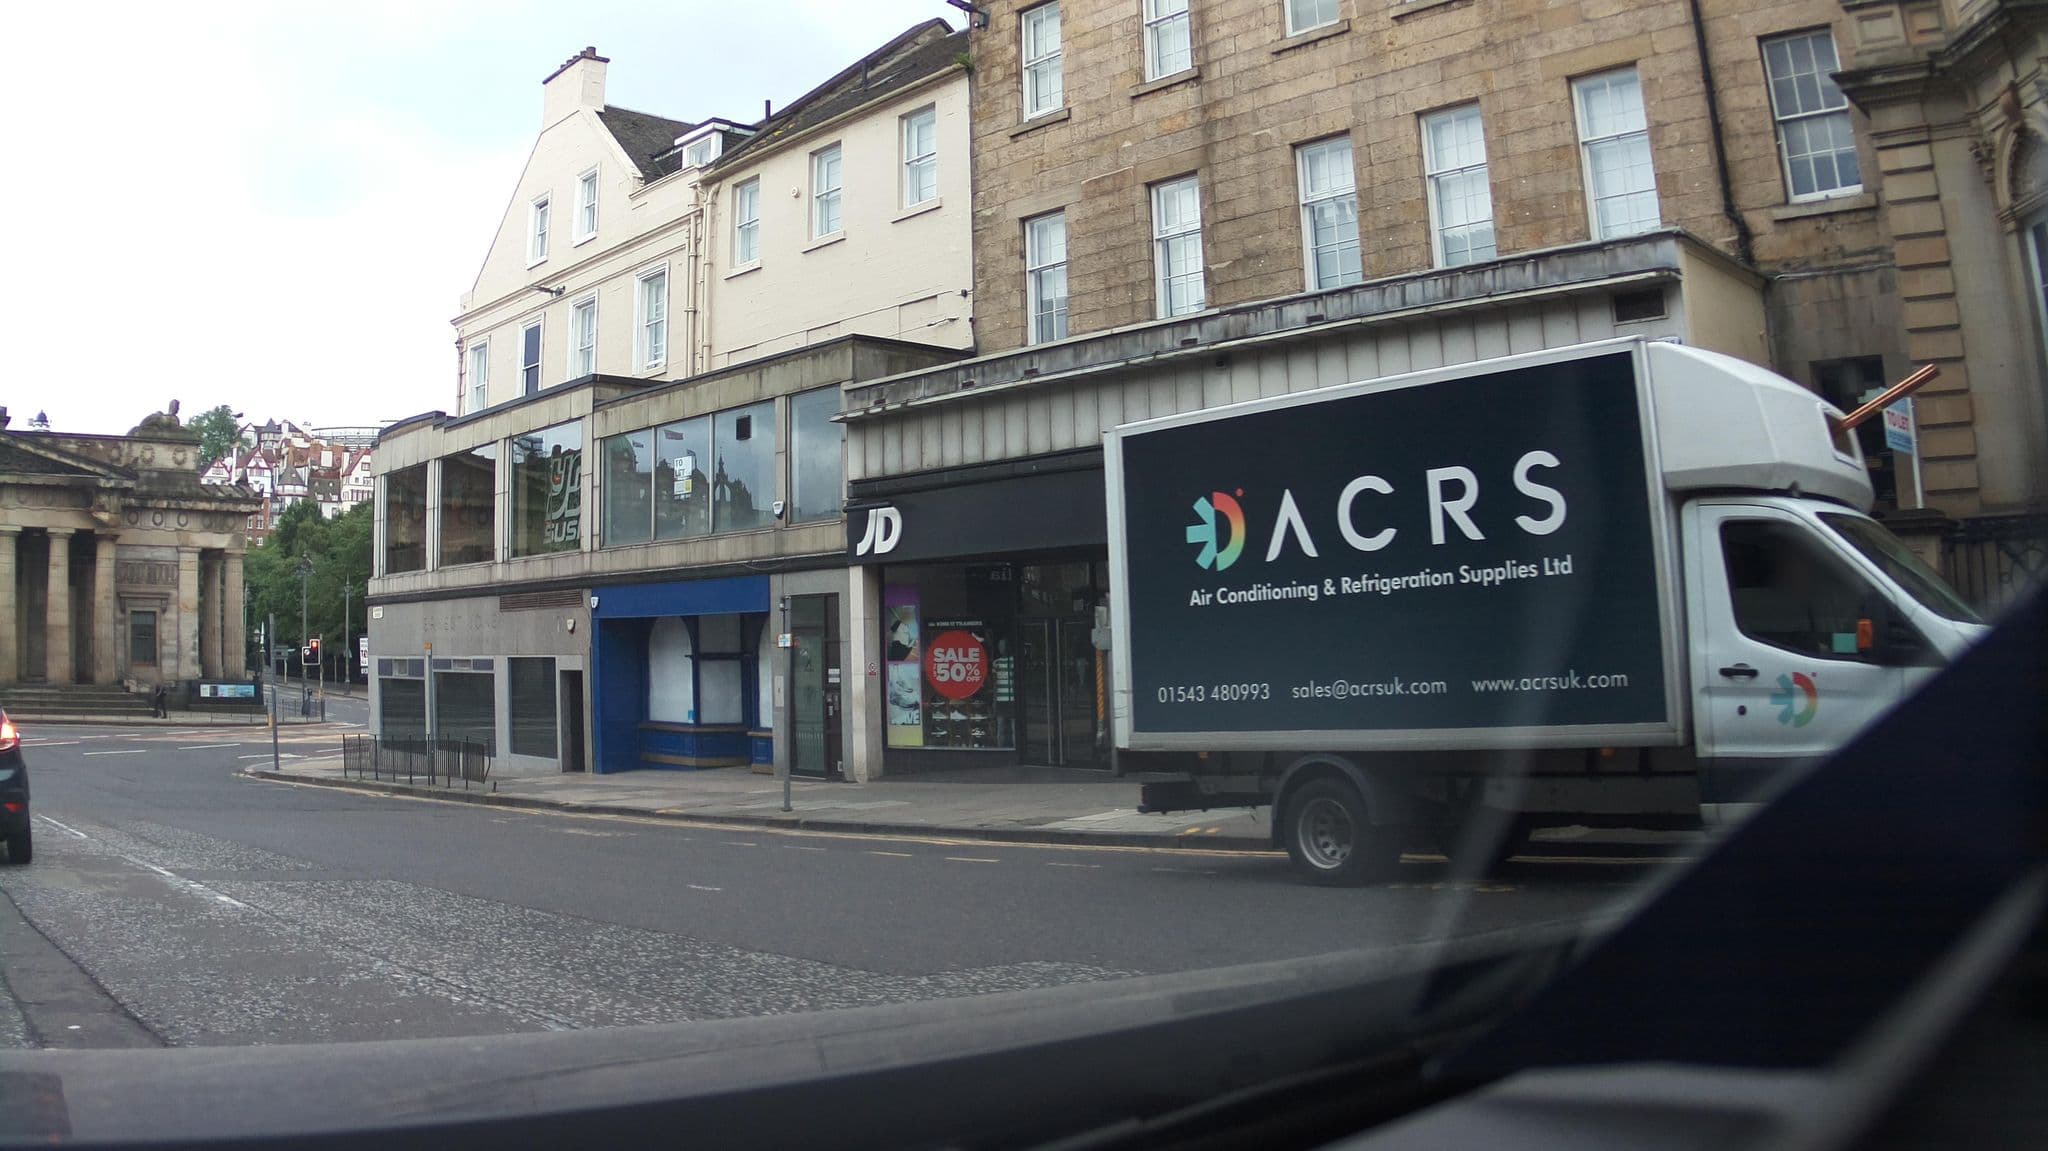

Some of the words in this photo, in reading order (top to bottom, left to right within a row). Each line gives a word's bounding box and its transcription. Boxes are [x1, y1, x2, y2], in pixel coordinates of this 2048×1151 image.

[1265, 450, 1568, 562] ACRS
[856, 506, 903, 556] JD
[1189, 588, 1212, 606] Air
[1216, 580, 1318, 604] Conditioning
[1323, 578, 1336, 596] &
[1341, 568, 1454, 595] Refrigeration
[1459, 560, 1539, 586] Supplies
[1544, 554, 1573, 576] Ltd
[933, 647, 980, 663] SALE
[936, 663, 980, 682] 50%
[1471, 669, 1628, 692] www.acrsuk.com
[1157, 685, 1205, 704] 01543
[1210, 682, 1271, 702] 480993
[1291, 676, 1447, 700] sales@acrsuk.com
